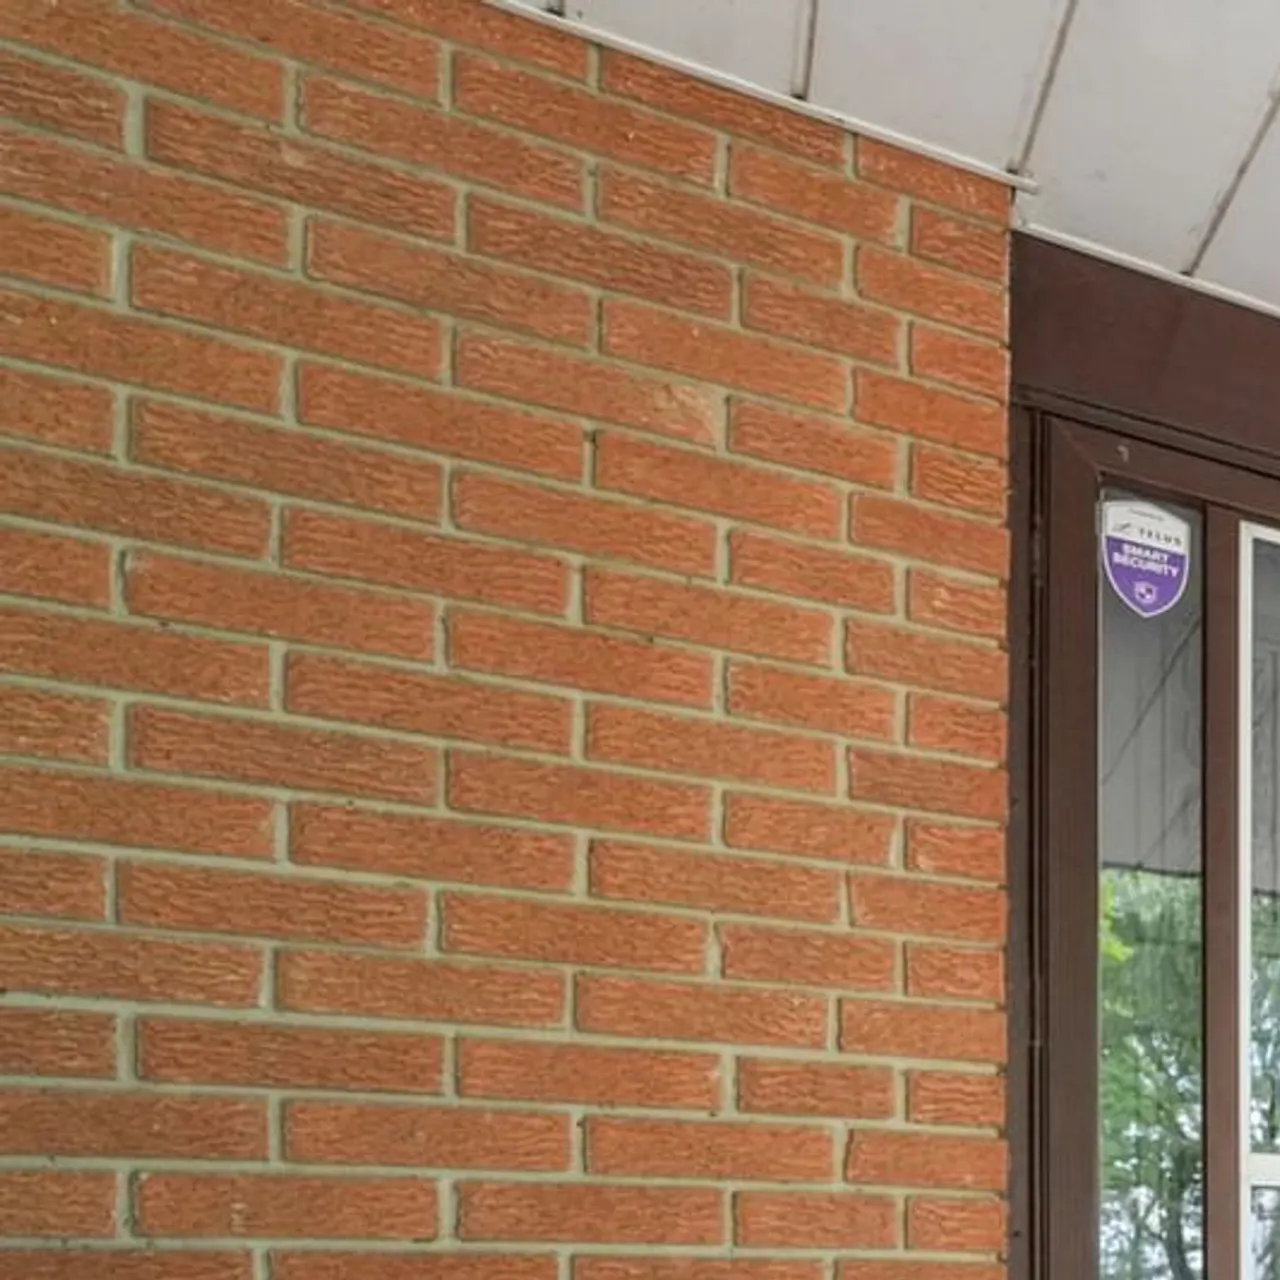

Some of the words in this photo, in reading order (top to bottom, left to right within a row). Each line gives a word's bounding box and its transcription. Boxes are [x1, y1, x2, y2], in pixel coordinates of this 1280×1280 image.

[1139, 527, 1182, 546] TELUS
[1122, 543, 1168, 561] SMART
[1112, 551, 1179, 577] SECURITY
